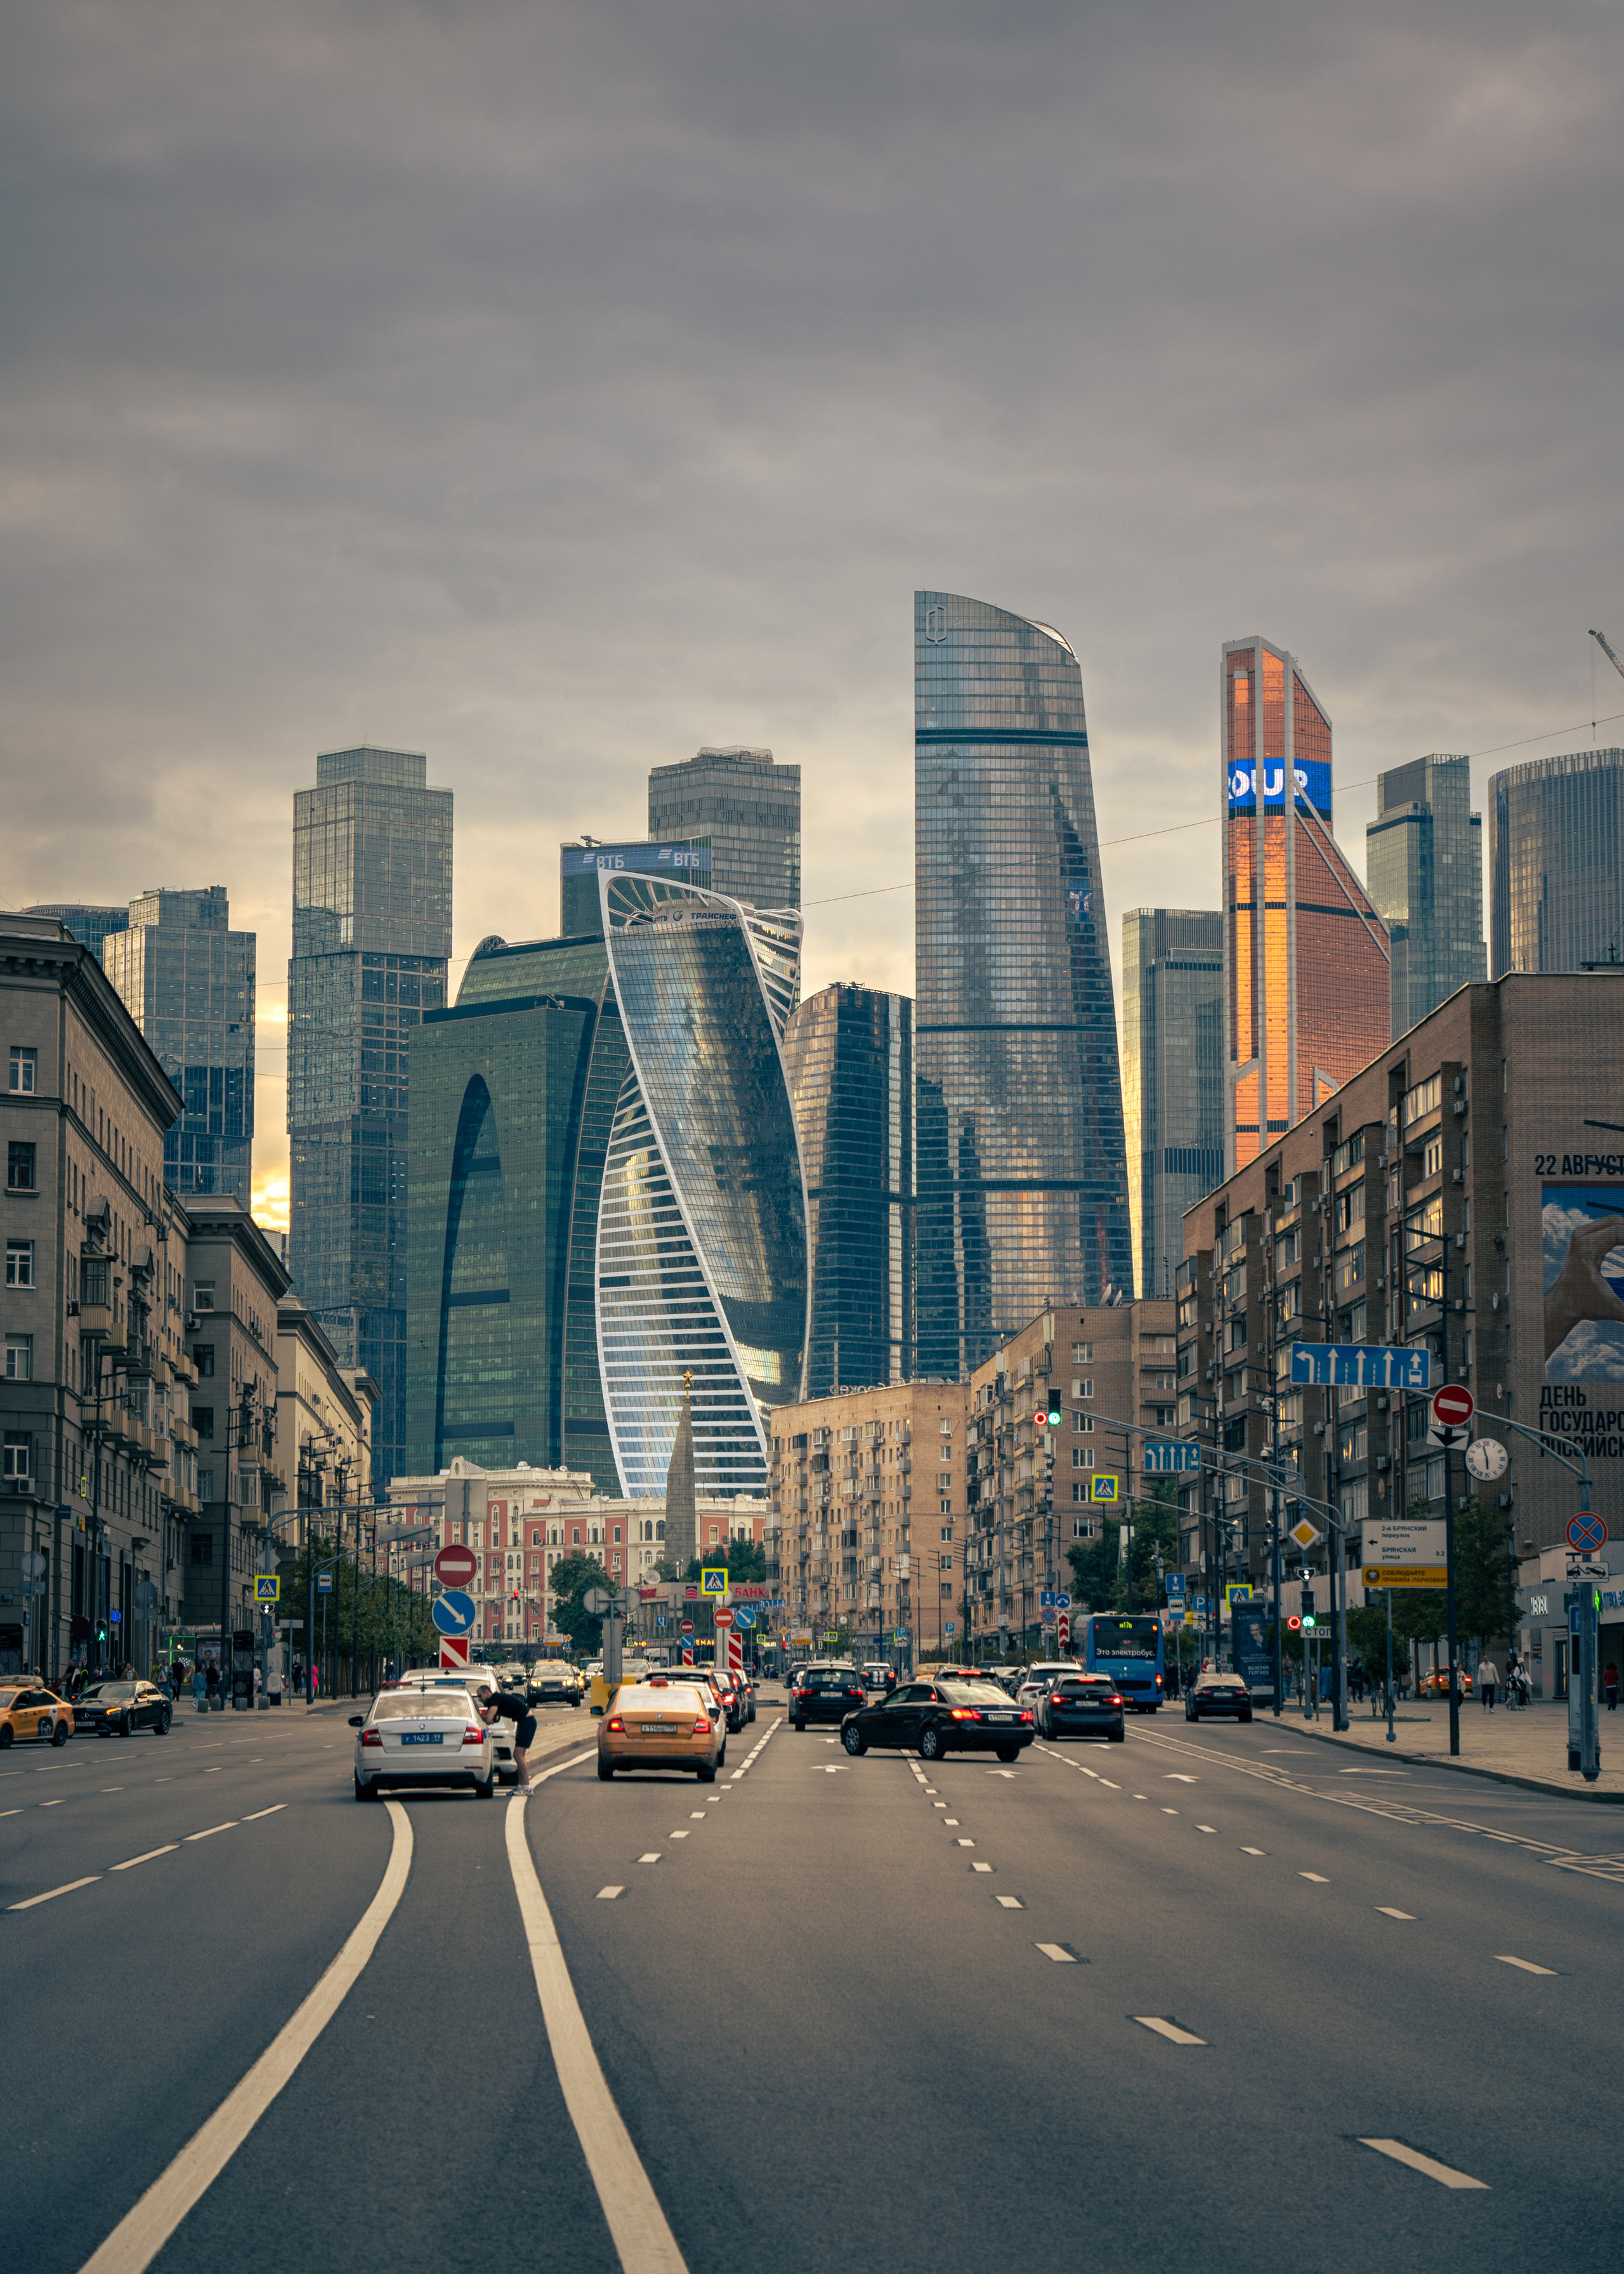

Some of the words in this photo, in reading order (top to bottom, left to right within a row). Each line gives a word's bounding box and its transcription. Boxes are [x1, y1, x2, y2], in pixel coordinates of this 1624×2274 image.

[597, 855, 624, 869] ВТБ
[674, 852, 699, 867] ВТБ
[1535, 1155, 1557, 1175] 22
[1539, 1385, 1587, 1409] ДЕНЬ
[1096, 1648, 1110, 1656] Это
[1111, 1648, 1156, 1658] электробус.
